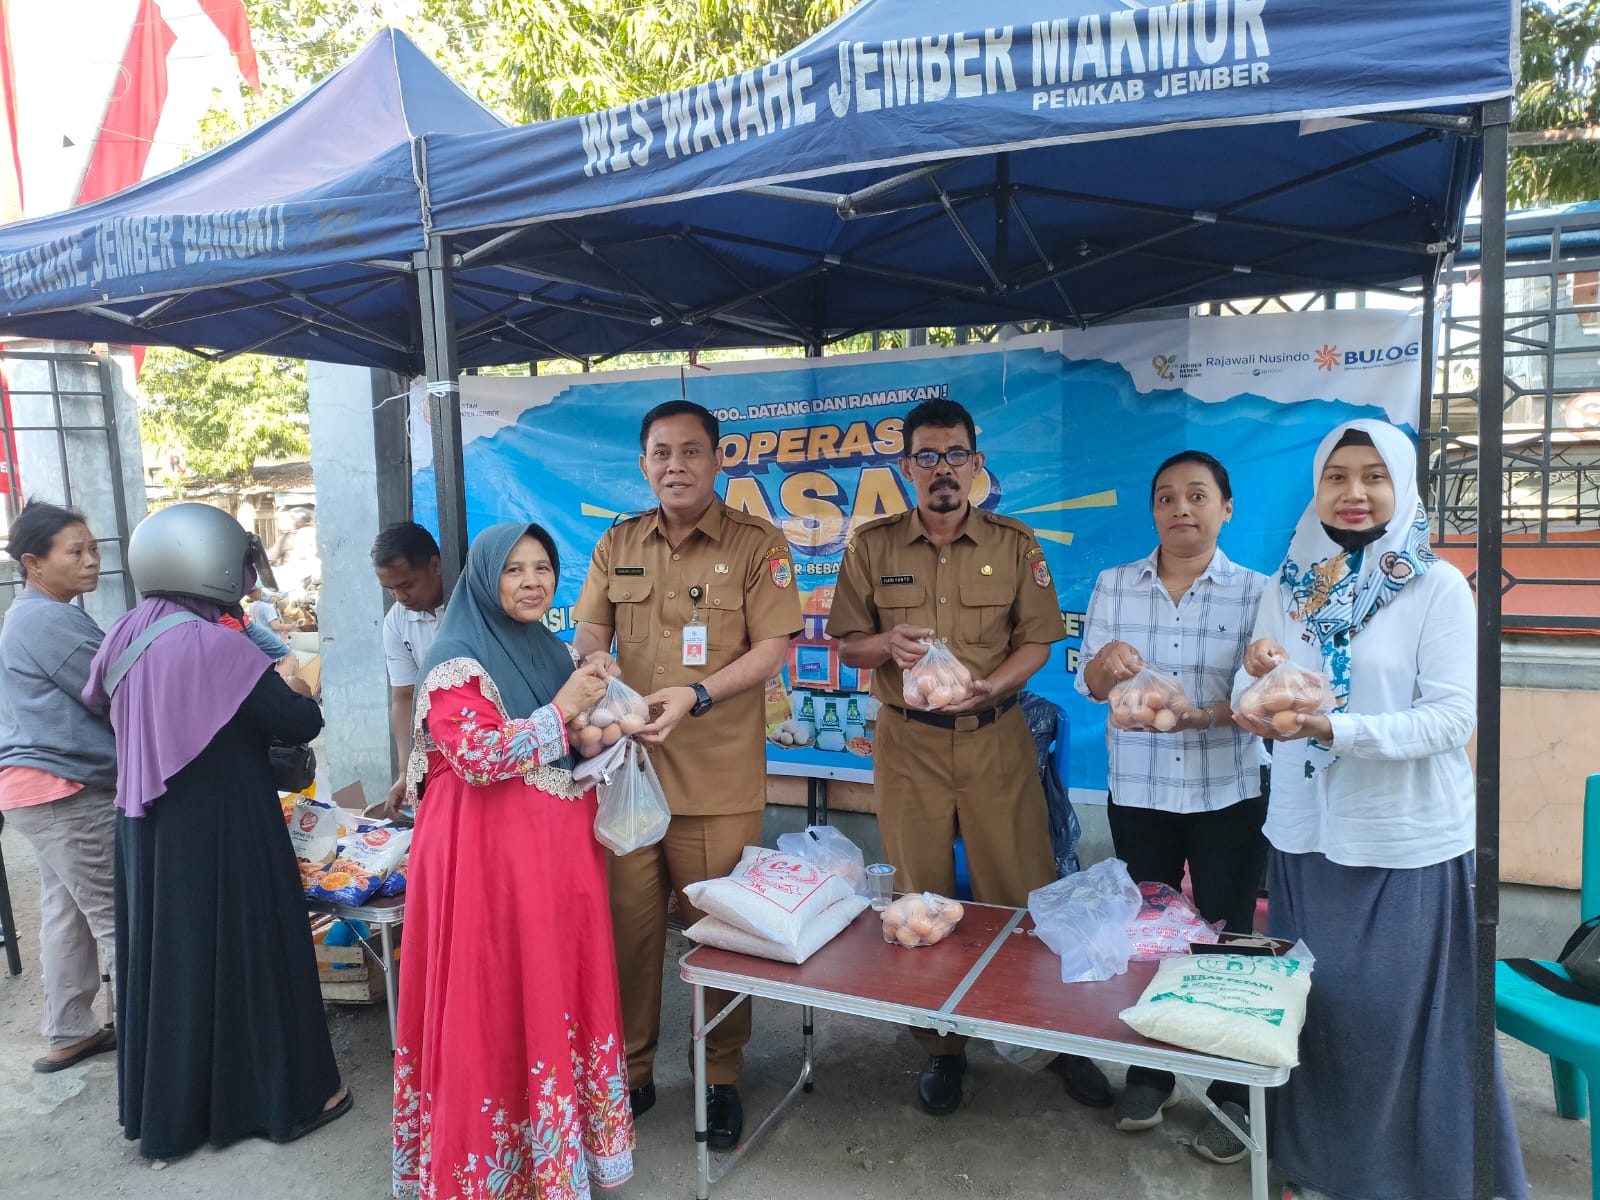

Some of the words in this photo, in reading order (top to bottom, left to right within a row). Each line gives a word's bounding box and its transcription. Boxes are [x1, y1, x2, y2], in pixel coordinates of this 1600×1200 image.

[579, 102, 653, 177] WES
[660, 58, 817, 159] WAYAHE
[828, 25, 1017, 118] JEMBER
[1031, 0, 1270, 87] MAKMUR
[1032, 79, 1145, 111] PEMKAB
[1154, 61, 1270, 98] JEMBER
[91, 215, 177, 283] JEMBER
[1206, 354, 1255, 367] Rajawali
[1259, 350, 1310, 363] Nusindo
[1344, 342, 1419, 365] BULOG
[748, 399, 811, 419] DATANG
[812, 395, 847, 413] DAN
